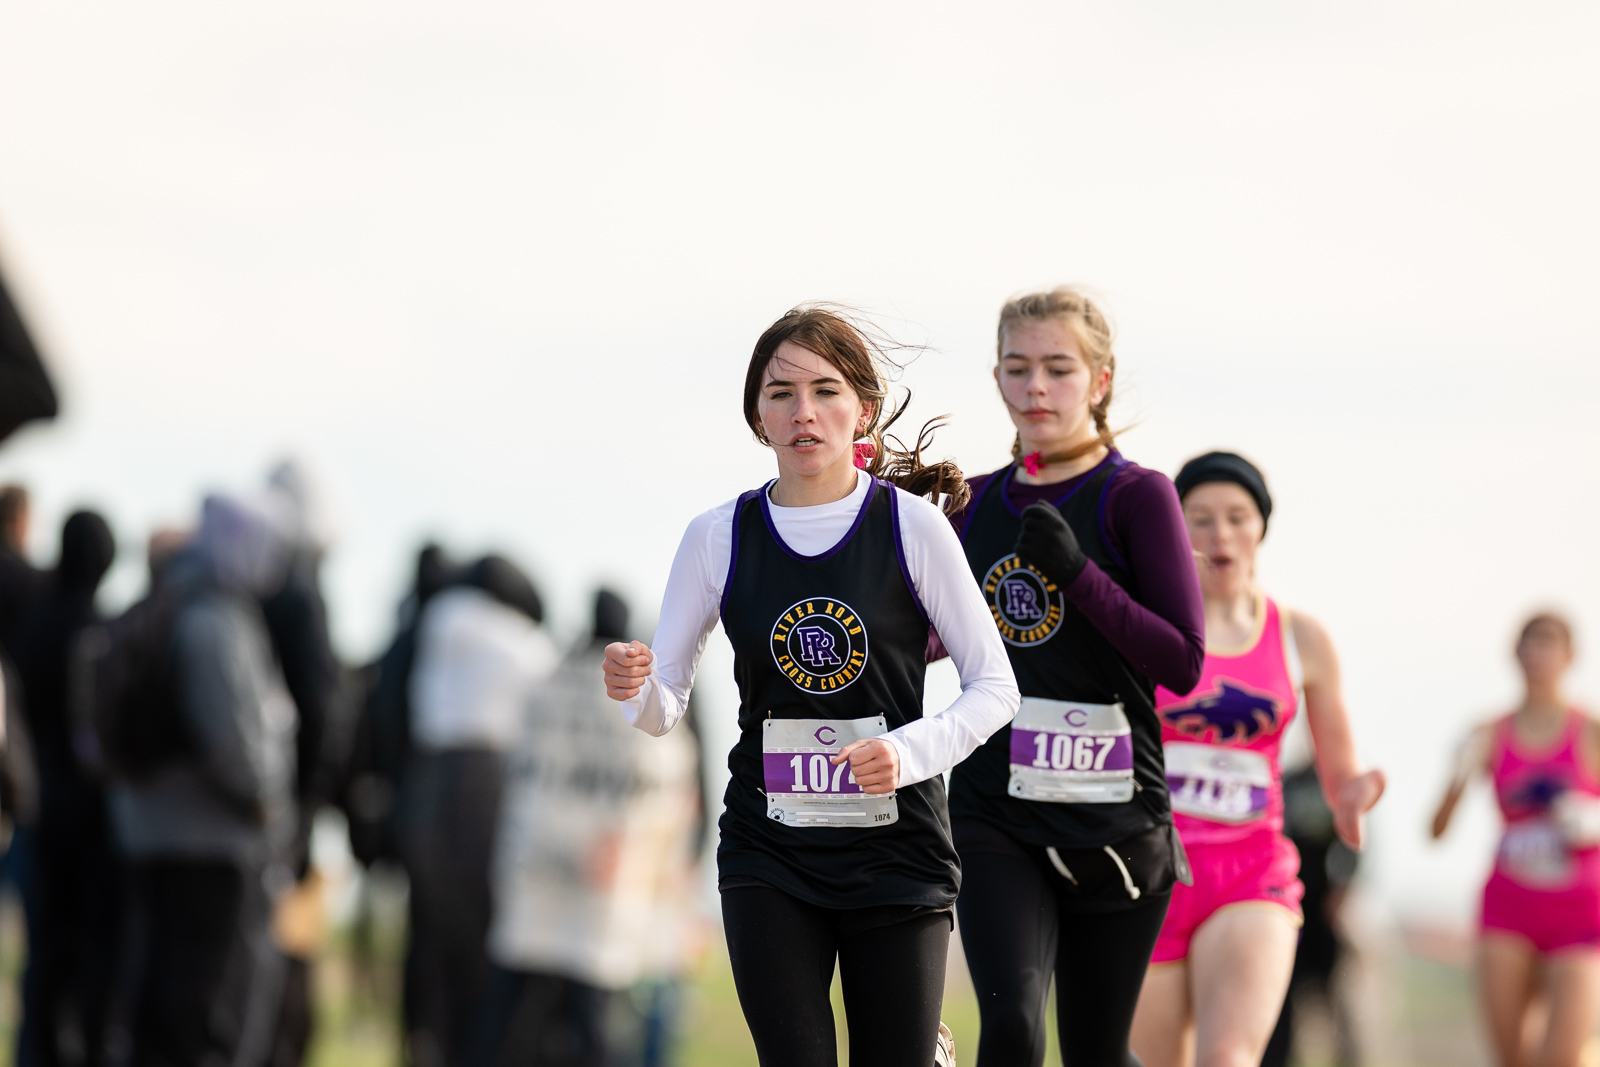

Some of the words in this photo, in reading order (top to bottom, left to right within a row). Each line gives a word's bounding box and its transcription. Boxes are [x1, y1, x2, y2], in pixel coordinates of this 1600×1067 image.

[774, 602, 815, 642] RIVER
[825, 602, 862, 635] ROAD
[778, 655, 813, 688] CROSS
[821, 649, 865, 690] COUNTRY
[1063, 708, 1088, 728] C
[814, 726, 837, 746] C
[1032, 732, 1116, 771] 1067
[874, 812, 891, 822] 1074
